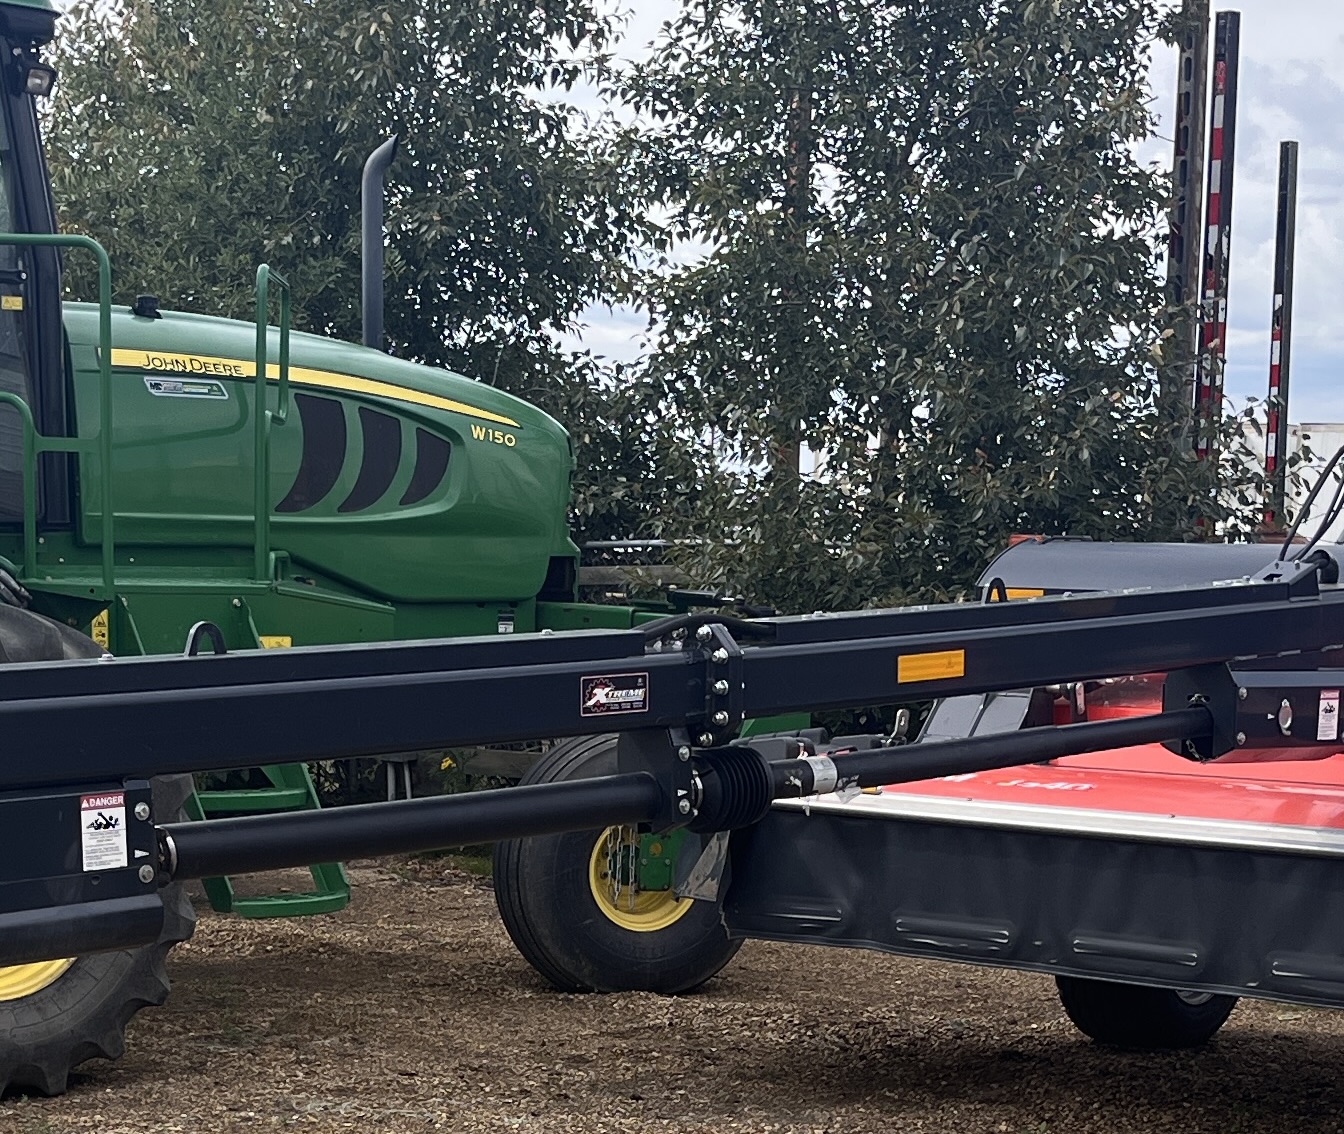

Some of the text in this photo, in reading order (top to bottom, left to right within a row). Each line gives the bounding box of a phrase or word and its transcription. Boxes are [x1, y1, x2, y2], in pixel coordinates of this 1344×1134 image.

[142, 354, 245, 376] JOHN DEERE
[470, 423, 516, 447] W150
[89, 795, 124, 807] DANGER
